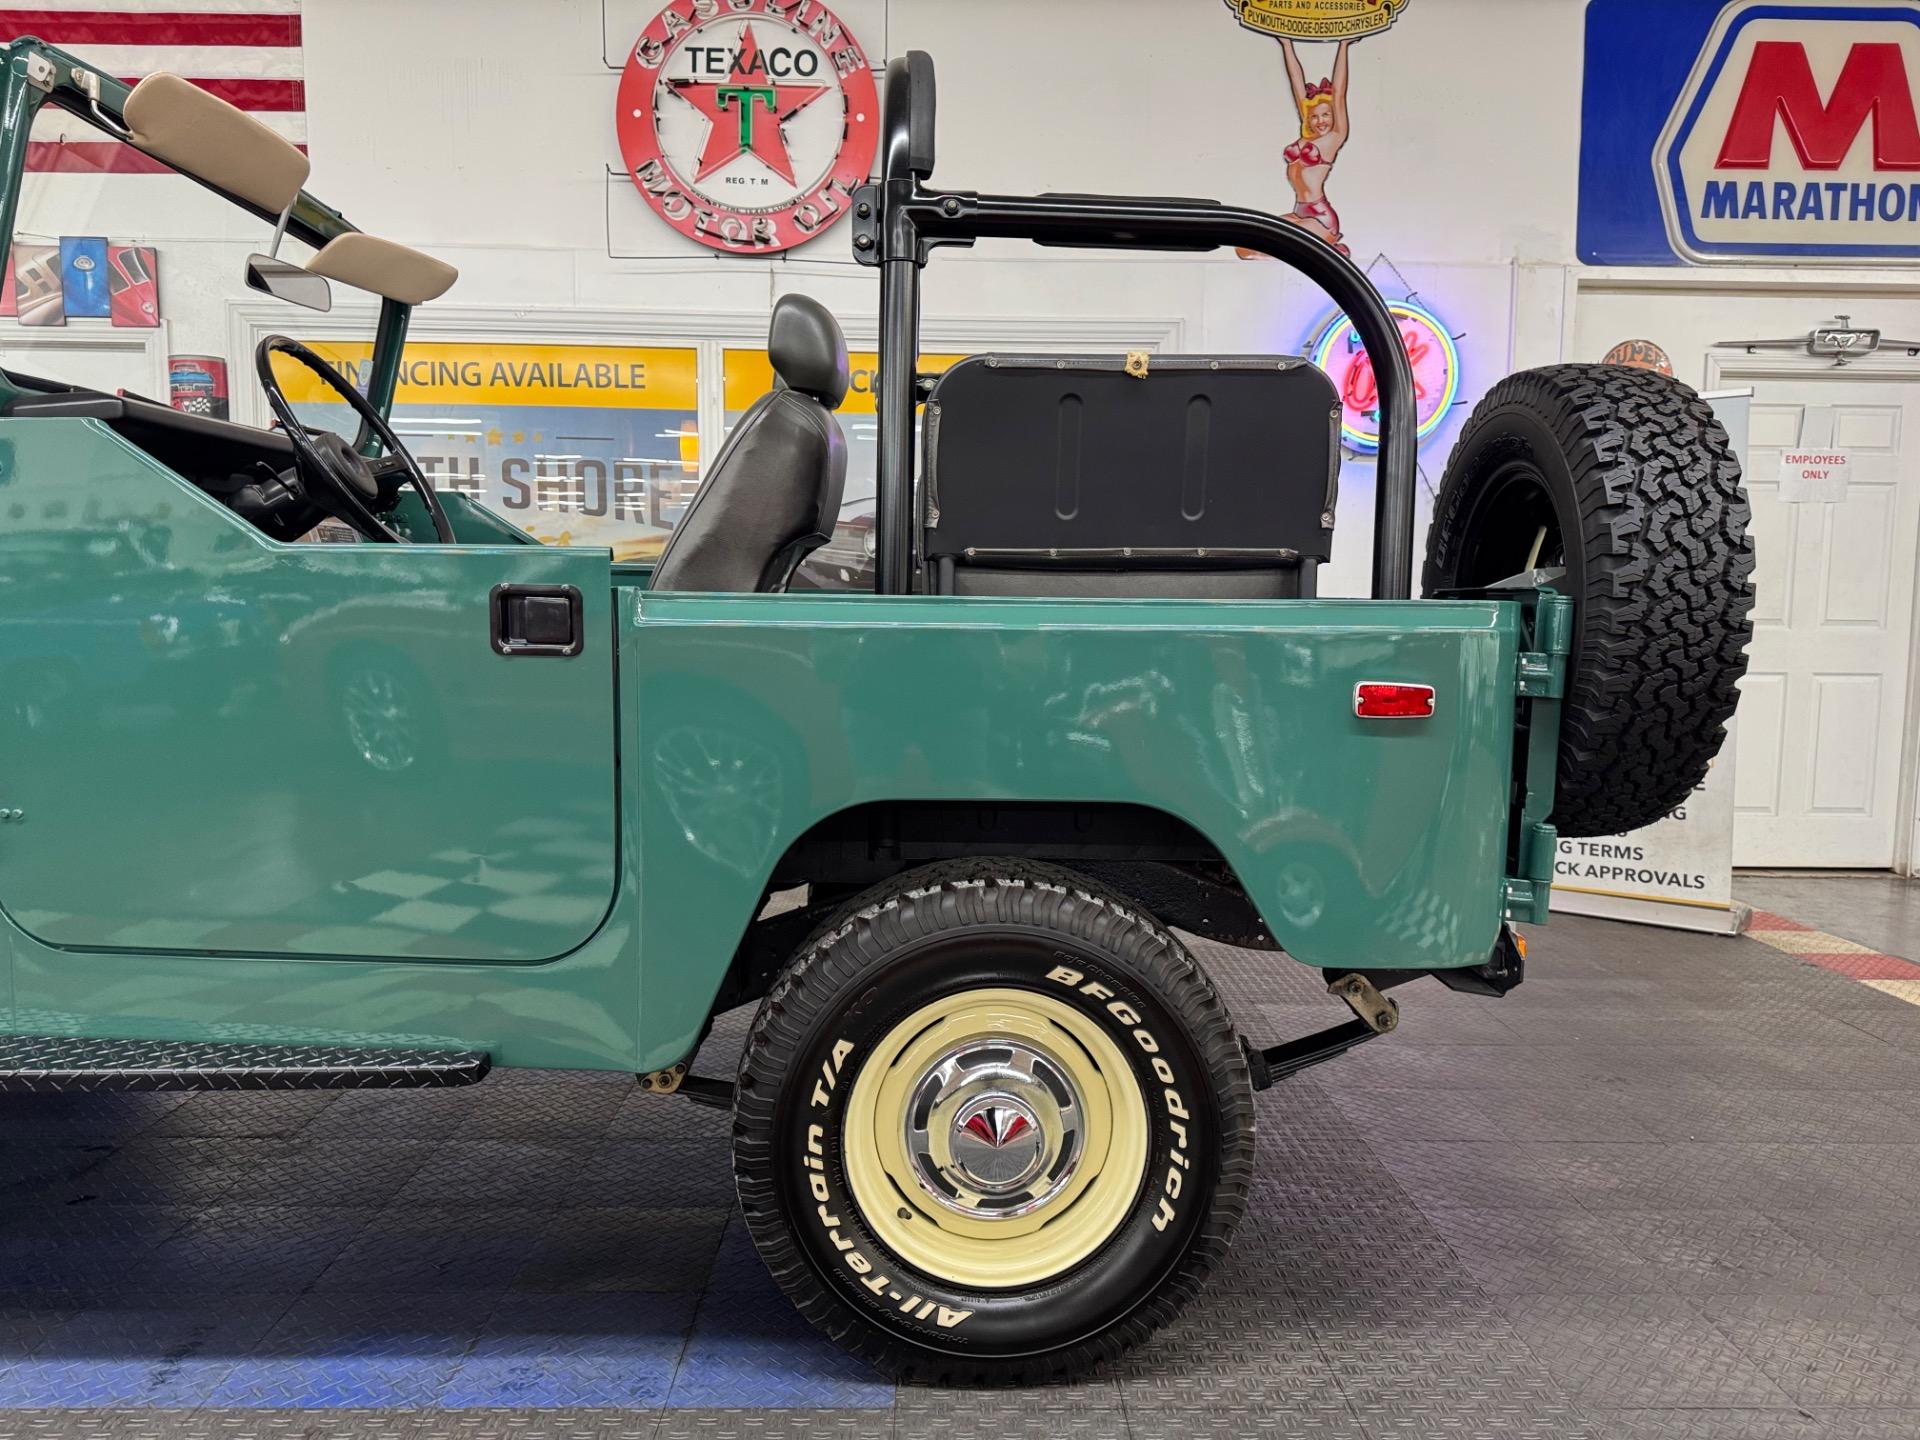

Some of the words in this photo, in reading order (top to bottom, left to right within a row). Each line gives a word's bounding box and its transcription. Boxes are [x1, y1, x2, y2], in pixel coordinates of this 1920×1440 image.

[1269, 1, 1292, 9] PARTS
[1296, 1, 1311, 9] AND
[1315, 1, 1366, 11] ACCESSORIES
[685, 47, 818, 77] TEXACO
[636, 159, 782, 249] MOTOR
[793, 177, 861, 234] OIL
[321, 360, 482, 388] INNCING
[489, 361, 647, 389] AVAILABLE
[1785, 454, 1846, 465] EMPLOYEES
[1802, 469, 1830, 479] ONLY
[502, 457, 674, 530] SHORE
[1578, 841, 1644, 861] TERMS
[1585, 864, 1705, 889] APPROVALS
[811, 1039, 855, 1107] T/A
[1045, 965, 1189, 1231] BFGoodrich
[804, 1124, 976, 1328] All-Terrain
